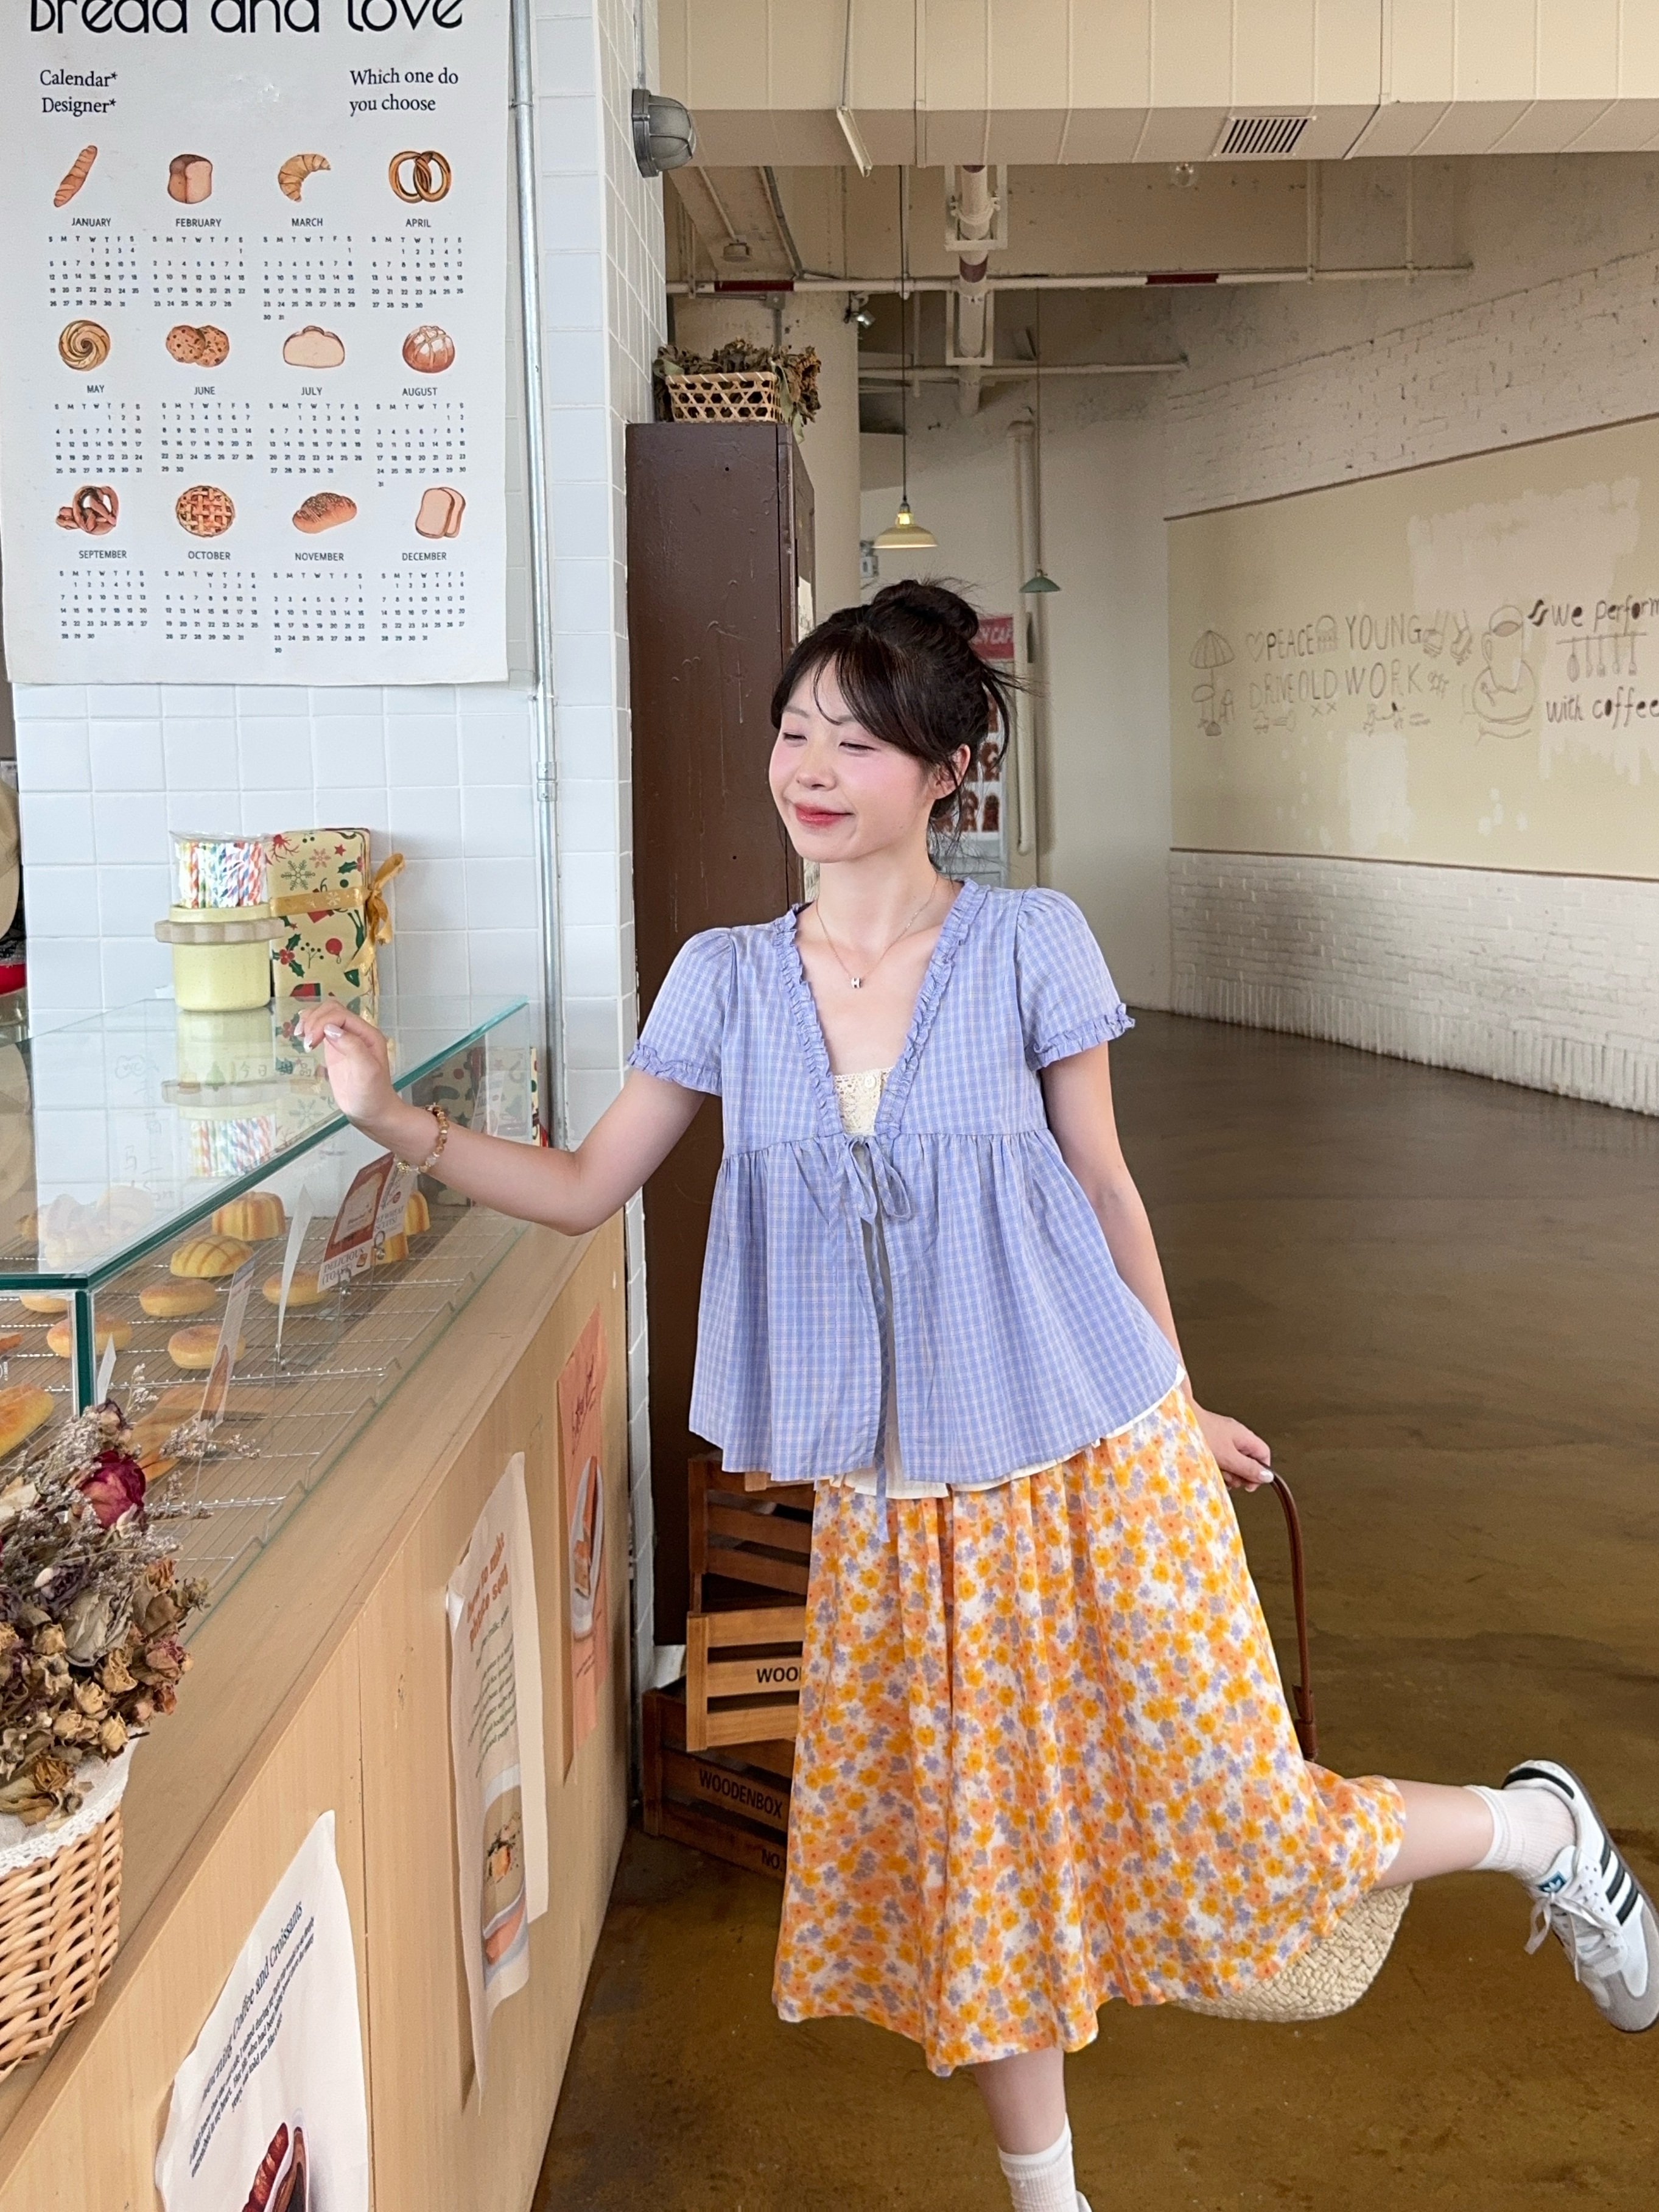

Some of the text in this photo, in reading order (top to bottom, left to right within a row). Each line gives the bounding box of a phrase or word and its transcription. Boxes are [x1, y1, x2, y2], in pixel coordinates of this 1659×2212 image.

[211, 0, 320, 33] and
[348, 0, 463, 32] love
[349, 67, 458, 85] Which one do
[349, 93, 436, 117] you choose
[72, 218, 111, 226] JANUARY
[176, 219, 221, 227] FEBRUARY
[292, 218, 323, 226] MARCH
[405, 219, 431, 227] APRIL
[194, 387, 215, 395] JUNE
[402, 387, 437, 396] AUGUST
[188, 551, 230, 560] OCTOBER
[402, 552, 446, 561] DECEMBER
[1552, 603, 1583, 627] we
[1266, 613, 1422, 661] PEACE YOUNG
[1345, 658, 1423, 699] WORK
[1546, 686, 1659, 730] with coffee
[700, 1768, 784, 1819] WOODENBOX
[233, 1988, 254, 2040] Coffee
[256, 1955, 269, 1995] and
[270, 1900, 303, 1968] Croissants
